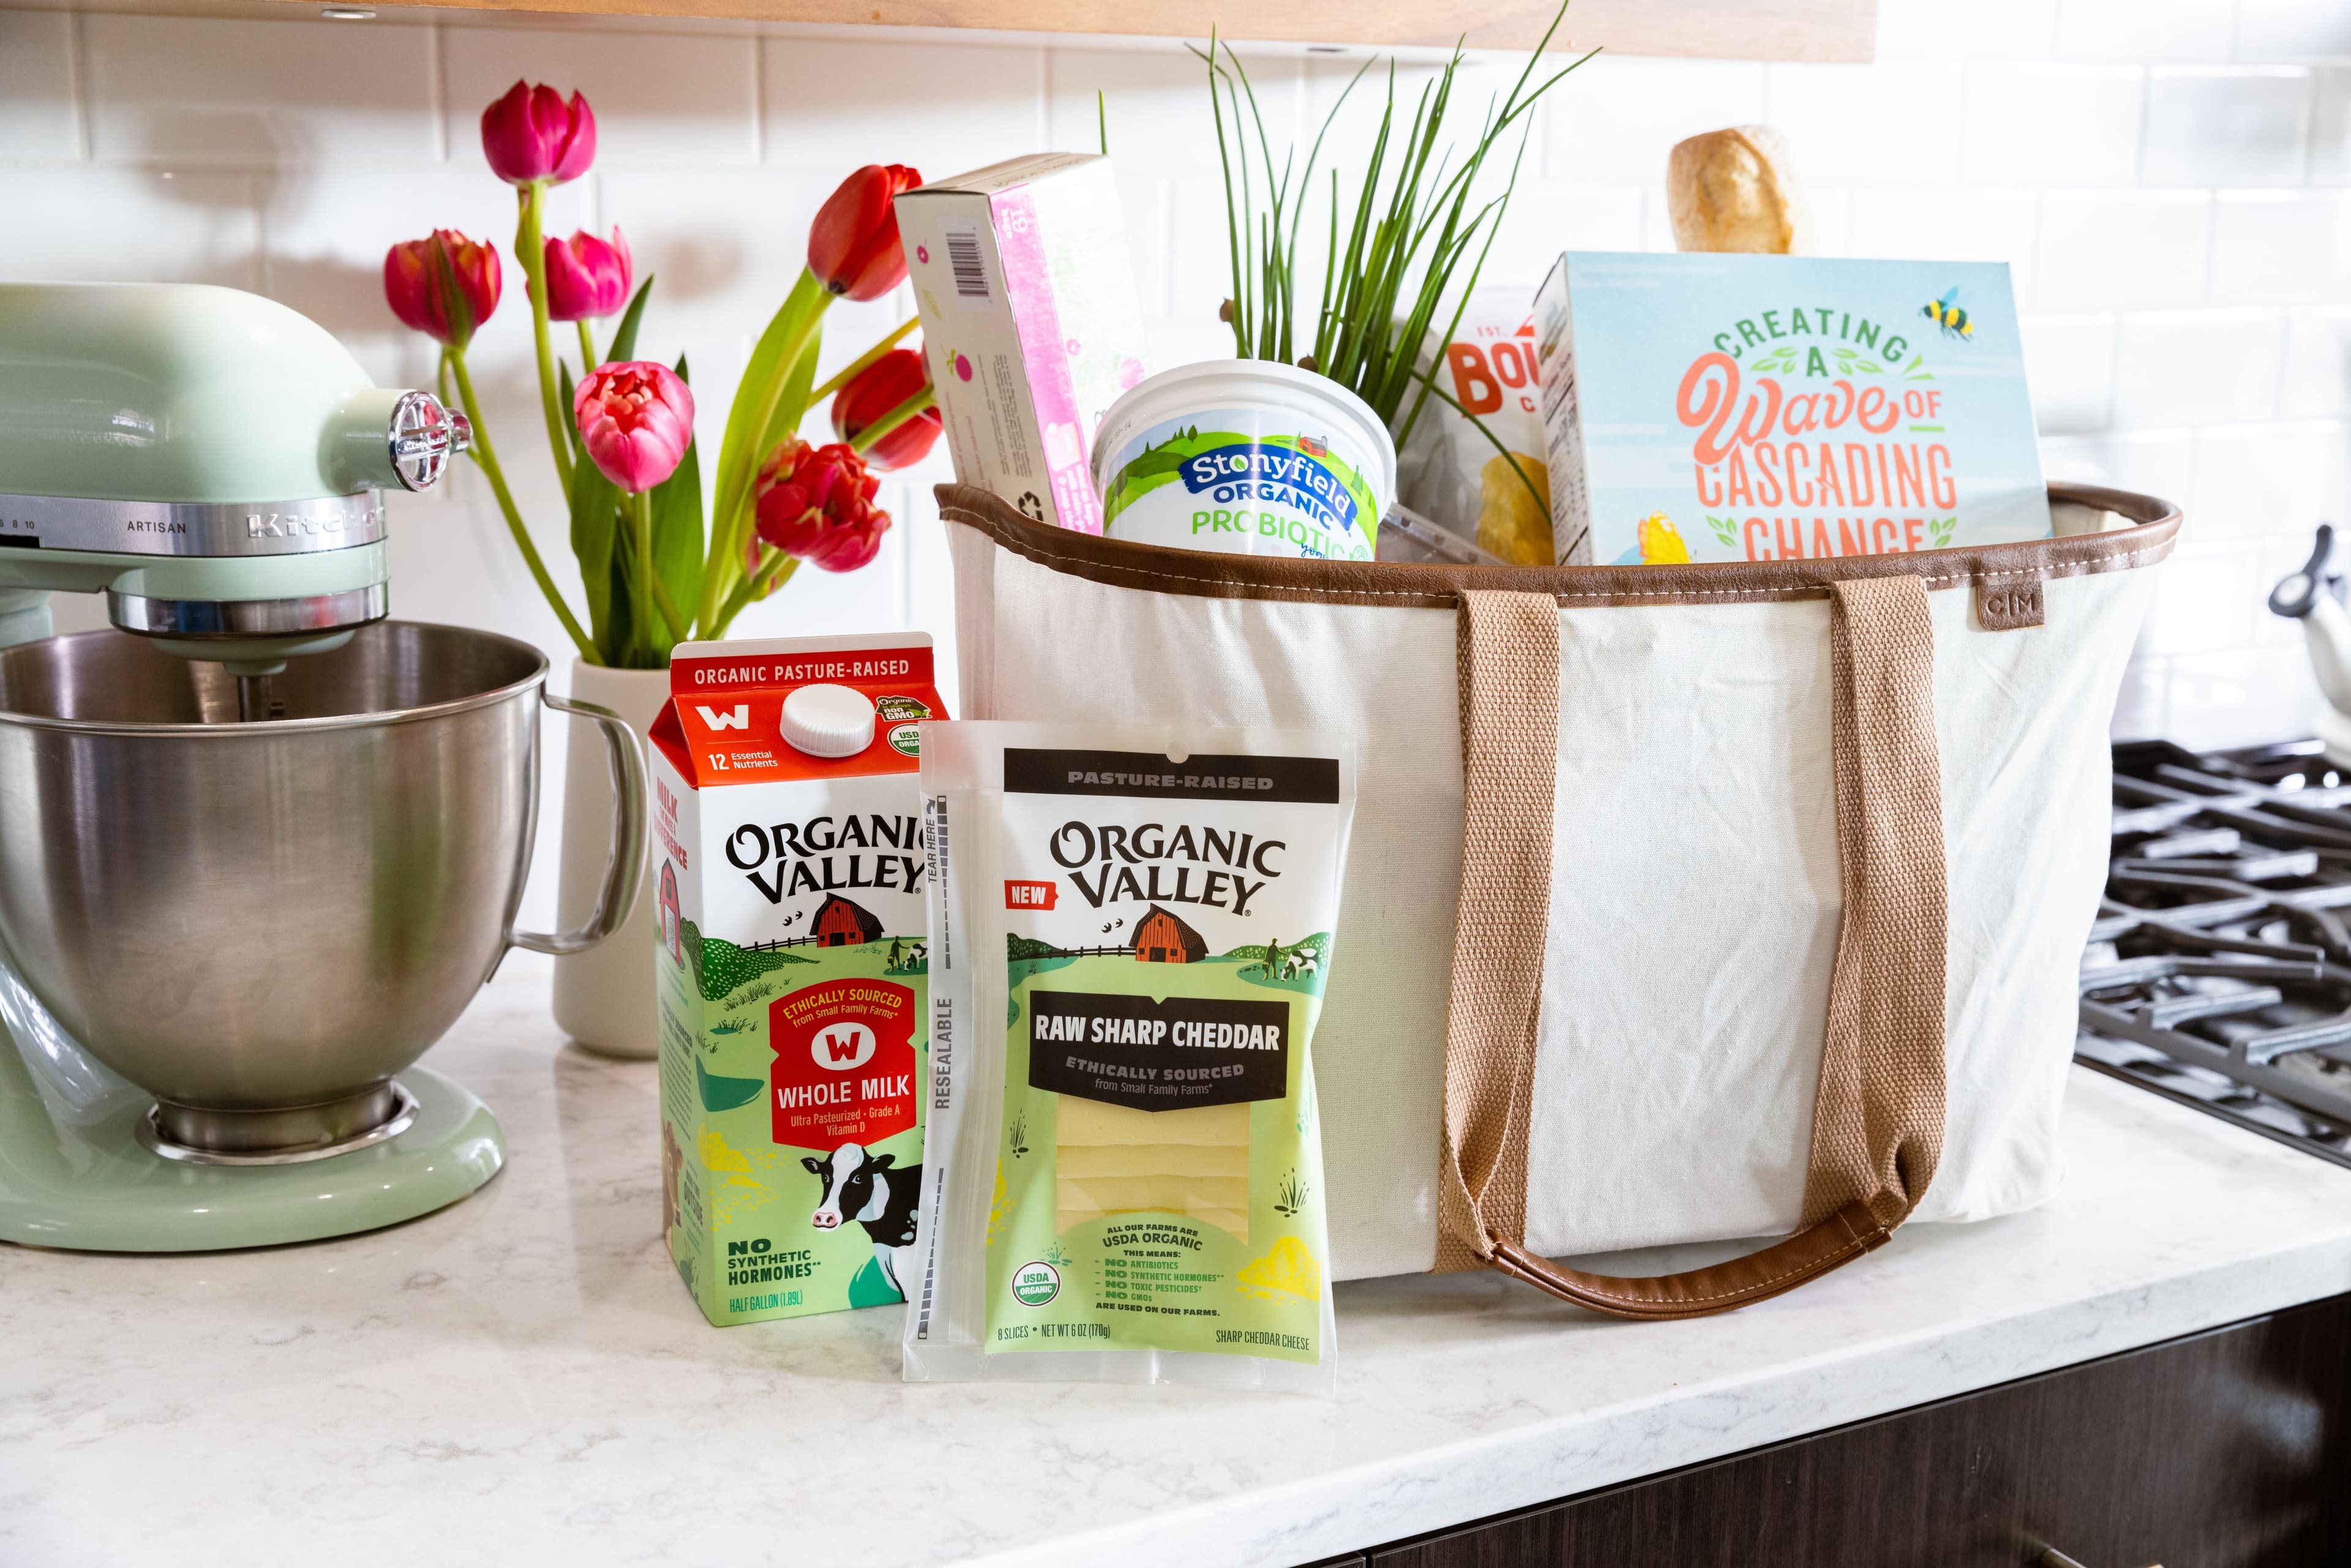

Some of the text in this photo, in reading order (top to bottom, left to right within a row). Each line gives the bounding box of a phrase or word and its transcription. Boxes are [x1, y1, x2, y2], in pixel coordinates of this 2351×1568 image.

[1714, 307, 1908, 362] CREATING
[1806, 346, 1829, 377] A
[1676, 351, 1941, 465] Wave OF
[1192, 452, 1351, 519] Stonyfield
[1693, 441, 1957, 510] CASCADING
[1213, 482, 1333, 530] ORGANIC
[12, 519, 18, 528] 8
[25, 520, 34, 530] 10
[127, 521, 186, 534] ARTISAN
[247, 507, 384, 538] Kitche
[1193, 509, 1345, 560] PROBIOTIC
[695, 660, 909, 685] ORGANIC PASTURE-RAISED
[695, 705, 749, 731] W
[886, 711, 915, 719] GMO
[708, 751, 772, 770] 12 Essential
[733, 760, 778, 769] Nutrients
[1068, 771, 1273, 790] PASTURE-RAISED
[657, 775, 678, 823] MILK
[726, 815, 924, 869] ORGANI
[926, 819, 937, 883] TEAR HERE
[1050, 820, 1286, 877] ORGANIC
[1011, 886, 1046, 904] NEW
[783, 988, 902, 1019] ETHICALLY SOURCED
[793, 1013, 814, 1027] from
[816, 1005, 838, 1018] Small
[841, 1004, 868, 1015] Family
[1035, 1015, 1280, 1051] RAW SHARP CHEDDAR
[825, 1031, 861, 1062] W
[936, 998, 952, 1109] RESEALABLE
[1065, 1056, 1245, 1081] ETHICALLY SOURCED
[778, 1075, 910, 1109] WHOLE MILK
[1095, 1078, 1118, 1092] from
[1120, 1082, 1146, 1093] Small
[1149, 1084, 1178, 1097] Family
[791, 1104, 900, 1127] Ultra Pasteurized Grade A
[827, 1122, 865, 1136] Vitamin D
[1102, 1232, 1203, 1251] USDA ORGANIC
[1107, 1226, 1123, 1234] ALL
[1179, 1227, 1198, 1237] ARE
[728, 1239, 771, 1256] NO
[727, 1250, 811, 1269] SYNTHETIC
[1105, 1258, 1179, 1269] NO ANTIBIOTICS
[1023, 1273, 1049, 1283] USDA
[1105, 1269, 1128, 1278] NO
[1131, 1272, 1172, 1281] SYNTHETIC
[1105, 1280, 1128, 1289] NO
[1131, 1283, 1153, 1291] TOXIC
[730, 1289, 803, 1313] HALF GALLON (1.89L)
[1019, 1285, 1052, 1296] ORGANIC
[1105, 1291, 1153, 1302] NO GMOs
[998, 1323, 1111, 1340] 8 SLICES NET WT 6 OZ (170g)
[1216, 1330, 1310, 1351] SHARP CHEDDAR CHEESE
